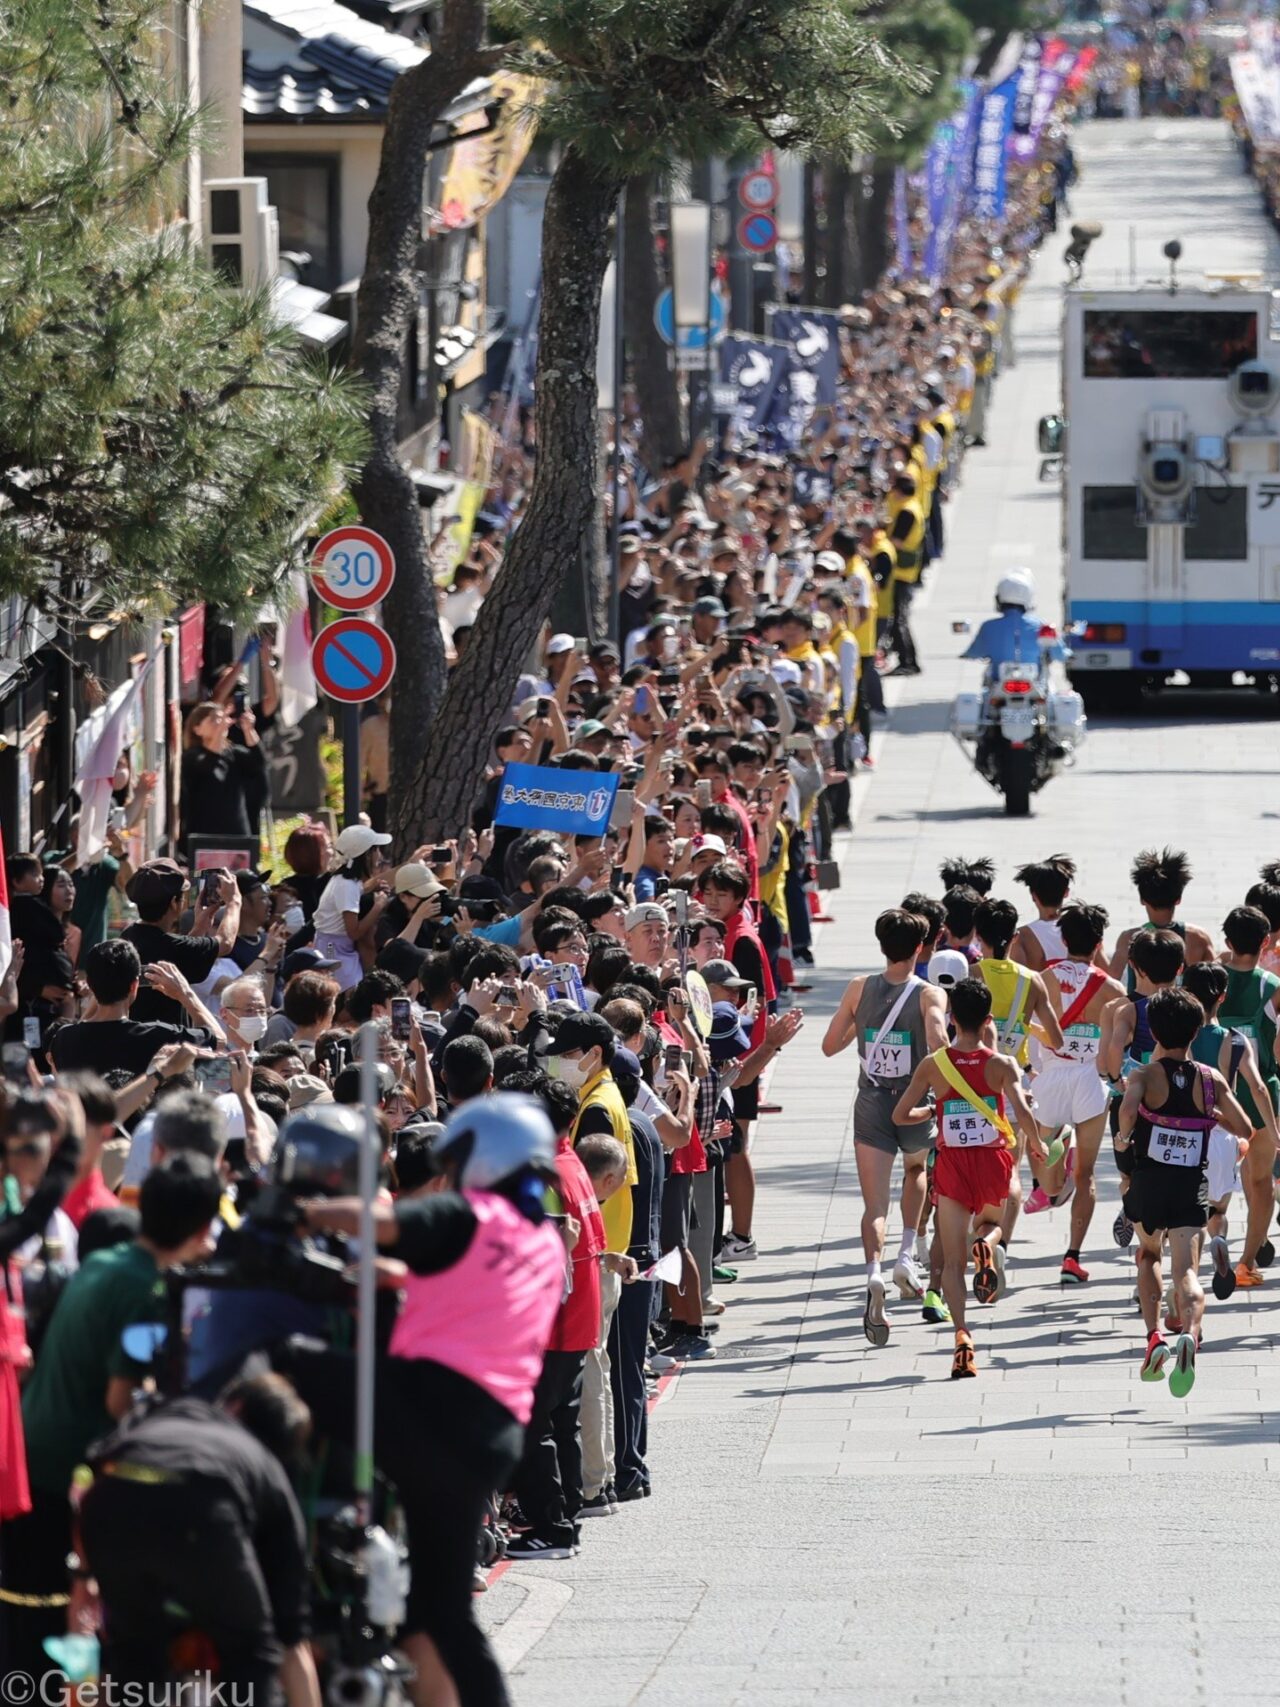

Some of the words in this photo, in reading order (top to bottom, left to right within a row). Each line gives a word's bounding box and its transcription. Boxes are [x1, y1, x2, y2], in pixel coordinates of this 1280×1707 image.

[332, 552, 374, 586] 30
[1069, 1041, 1095, 1053] 央大
[949, 1118, 992, 1130] 城西大
[959, 1132, 984, 1144] 9-1
[1157, 1133, 1197, 1149] 國學院大
[1163, 1149, 1187, 1163] 6-1
